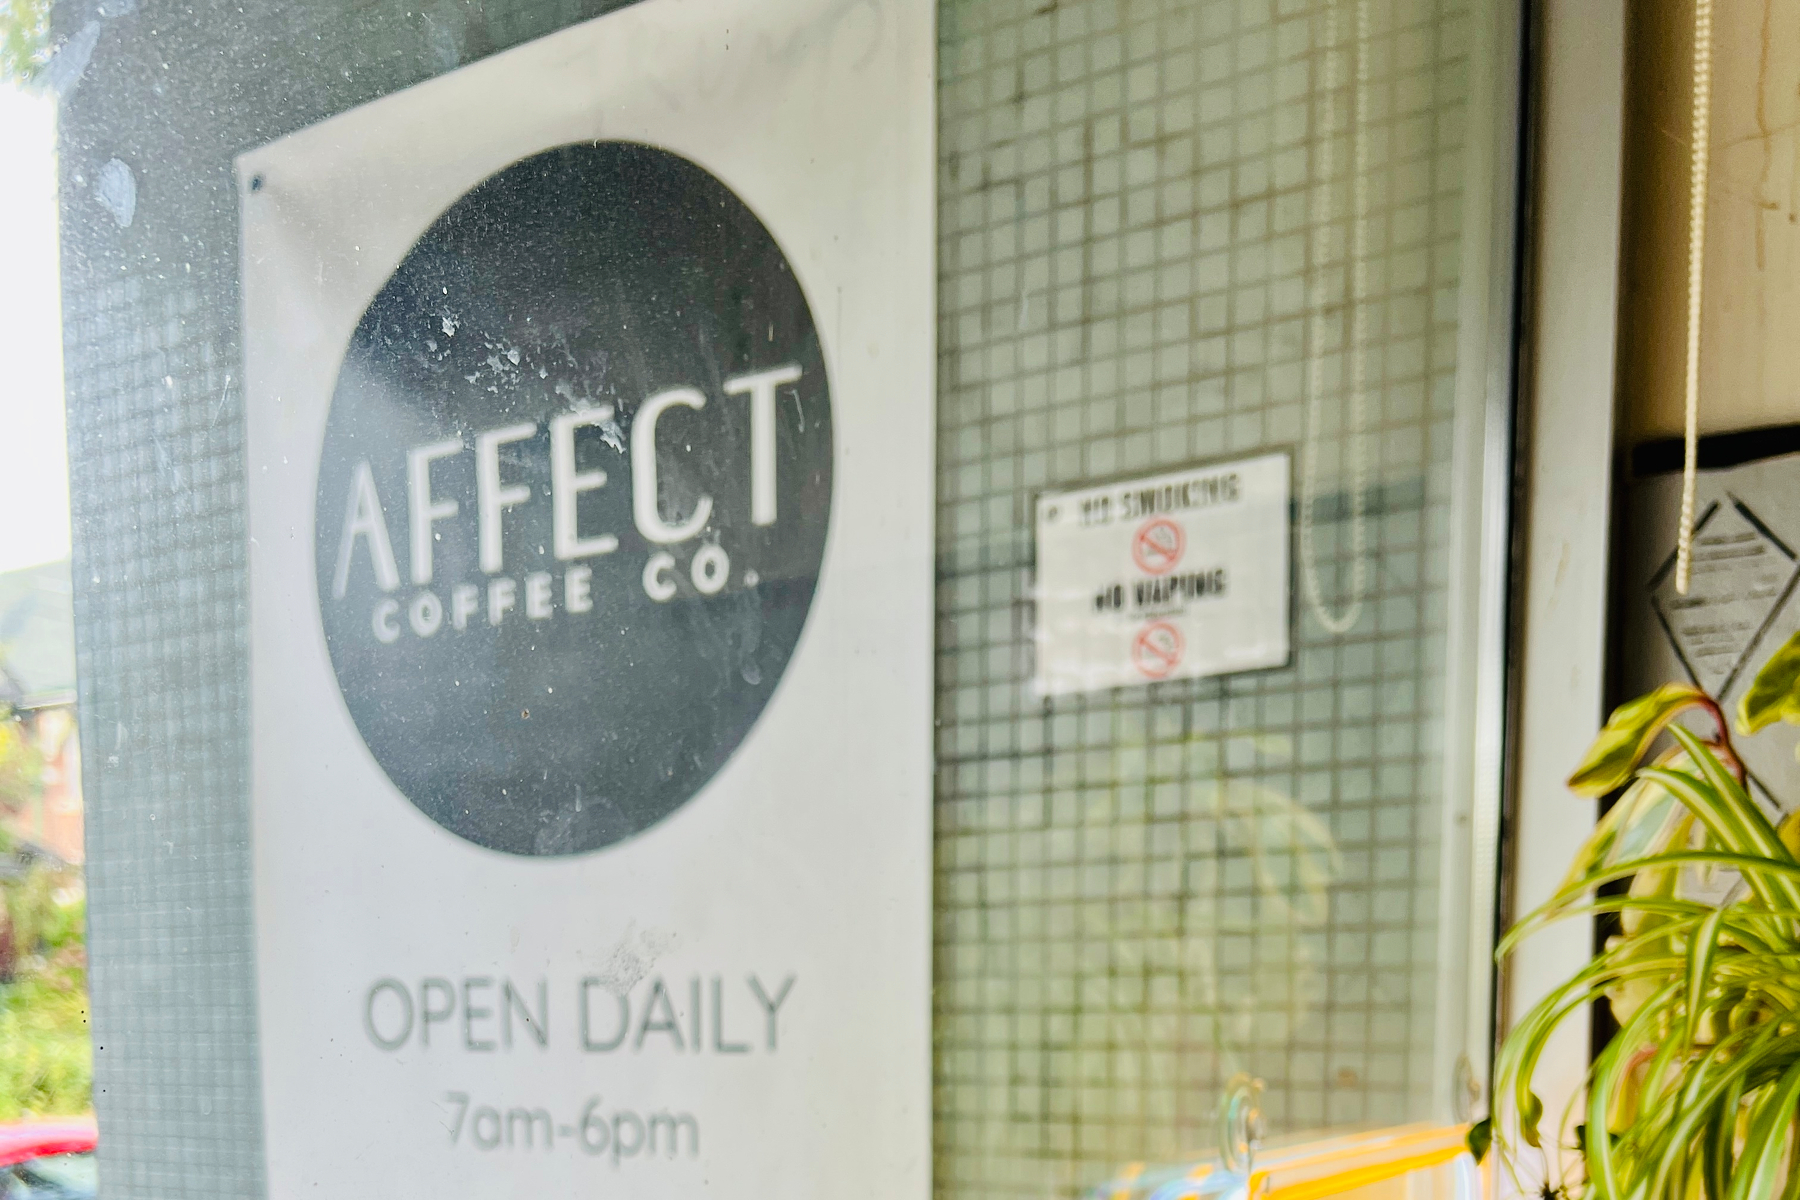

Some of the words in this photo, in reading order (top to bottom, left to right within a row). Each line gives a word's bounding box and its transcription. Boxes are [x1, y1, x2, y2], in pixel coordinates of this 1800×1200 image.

[332, 364, 802, 598] AFFECT
[371, 565, 594, 643] COFFEE
[641, 544, 759, 603] CO.
[363, 975, 549, 1053] OPEN
[578, 973, 797, 1054] DAILY
[446, 1090, 701, 1167] 7am-6pm
